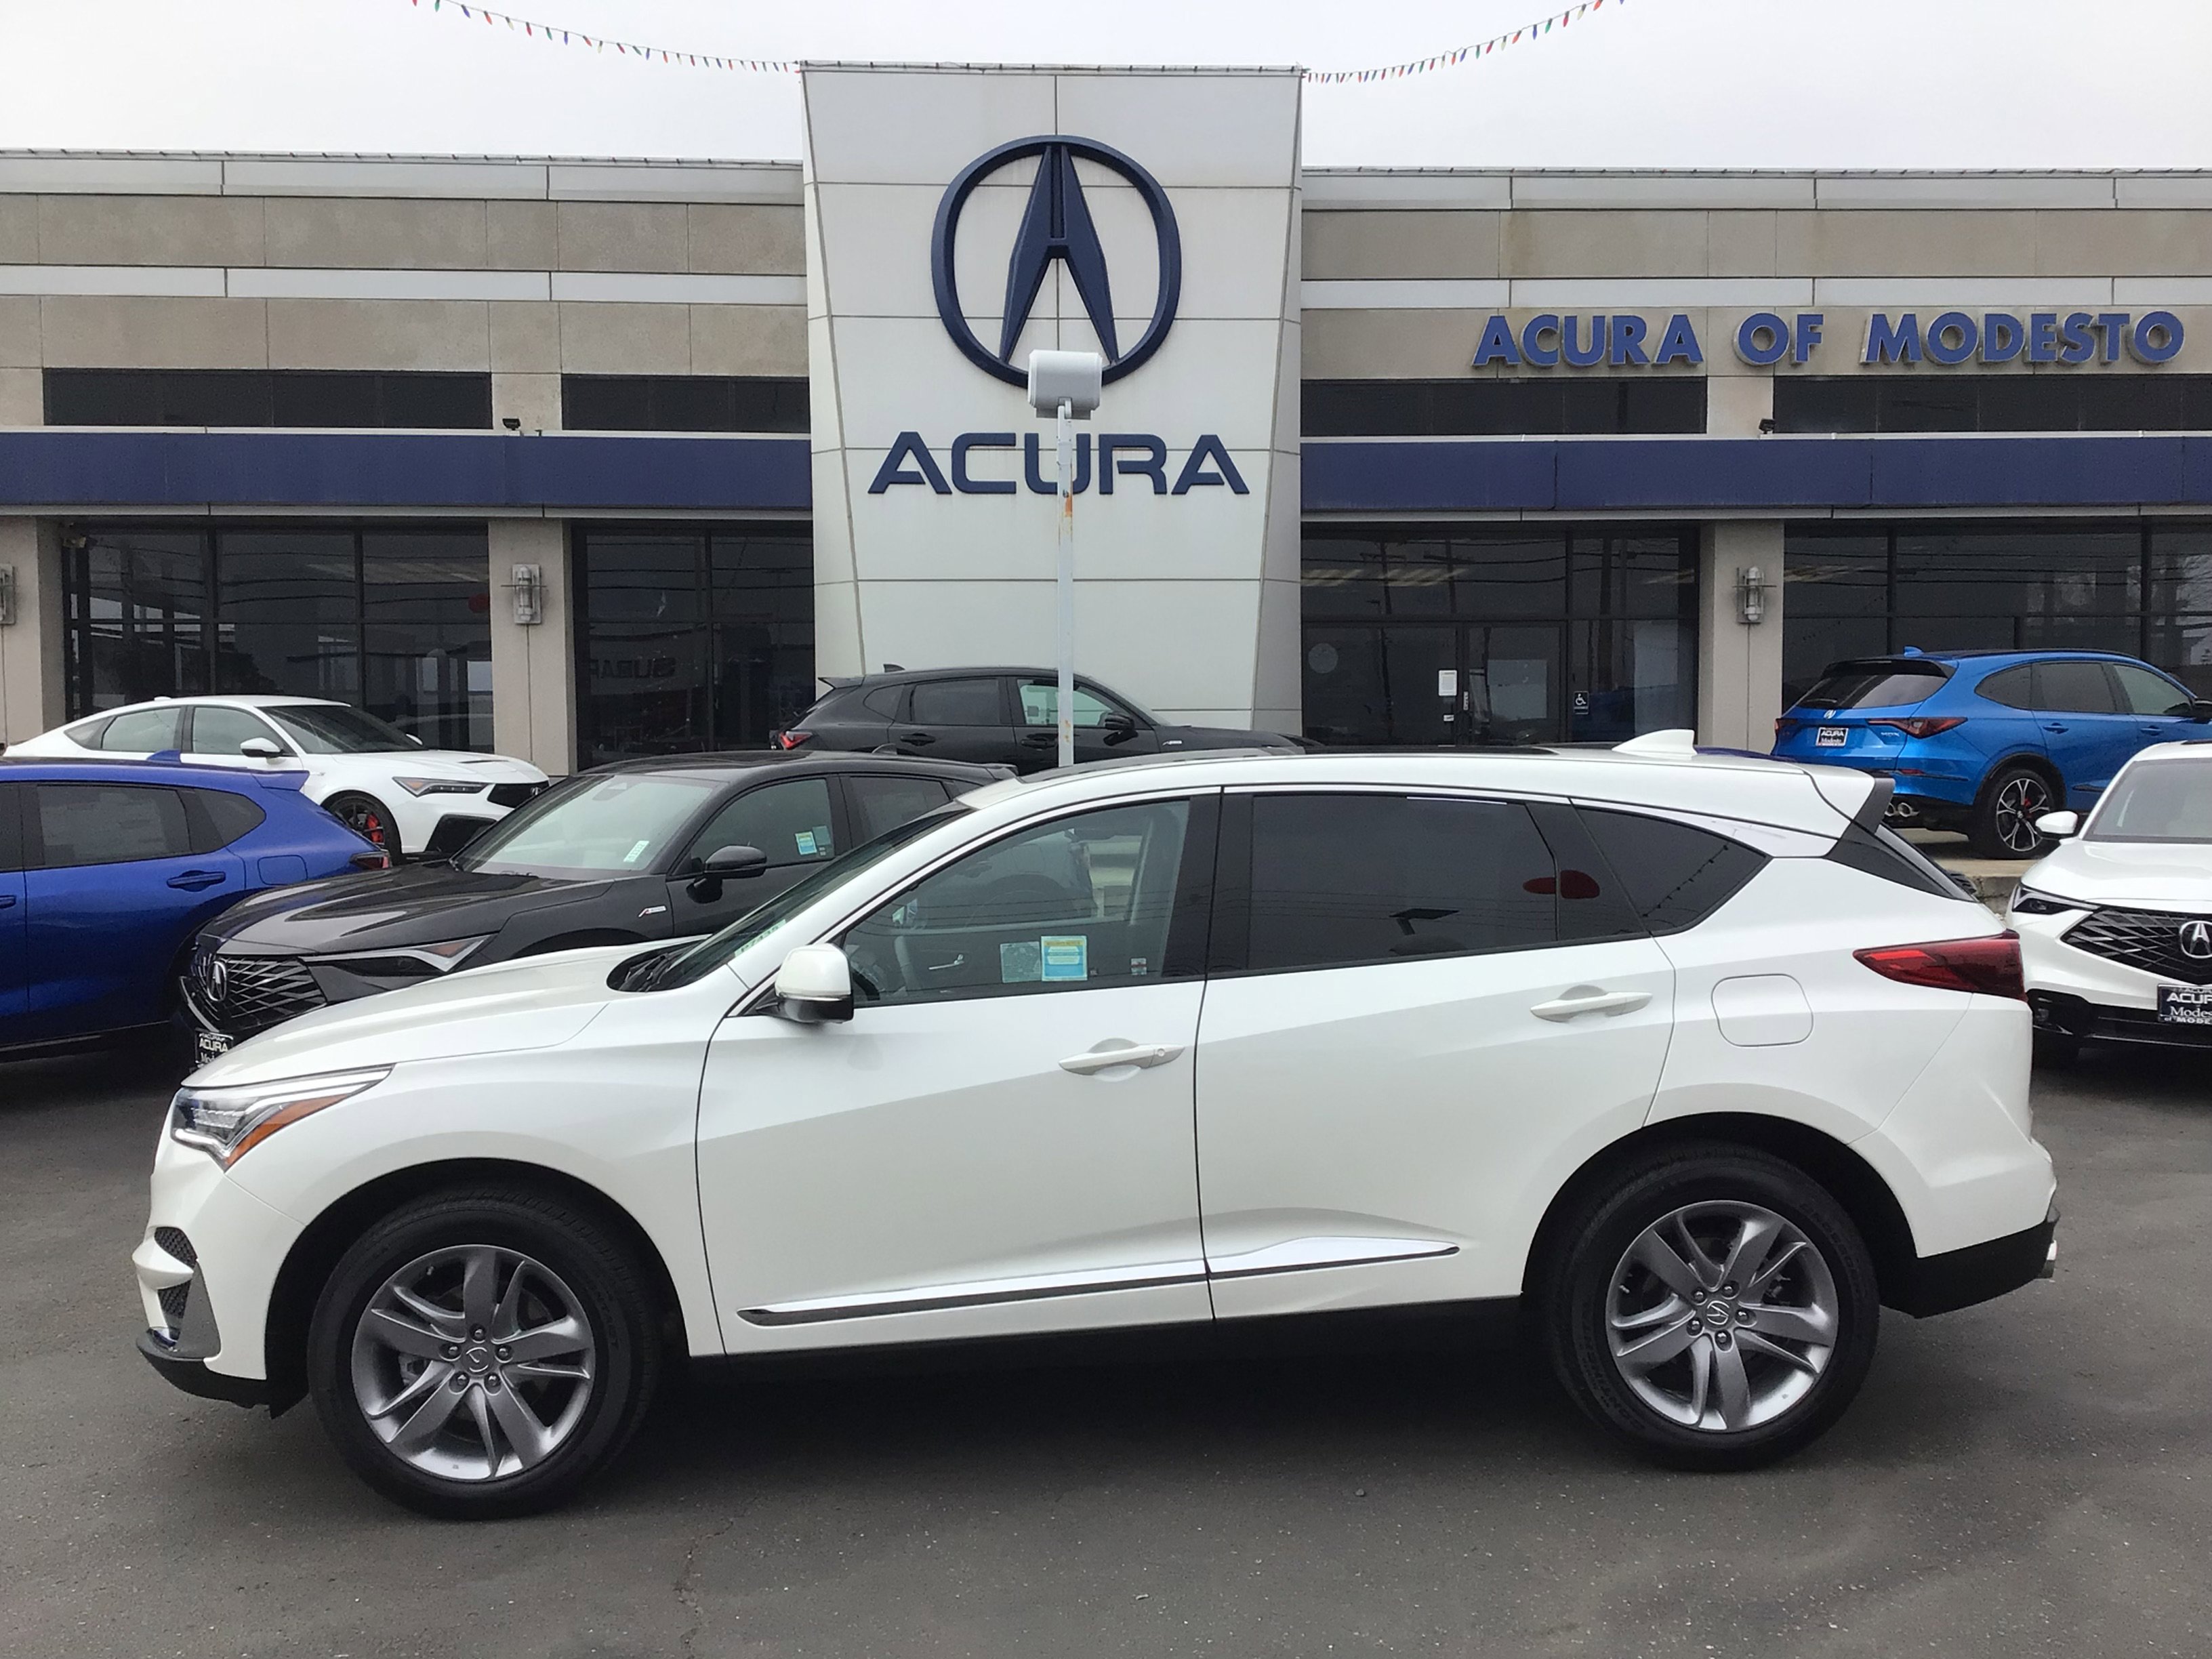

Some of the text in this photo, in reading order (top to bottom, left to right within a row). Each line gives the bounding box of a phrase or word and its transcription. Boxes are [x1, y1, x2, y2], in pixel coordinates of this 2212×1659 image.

[1471, 310, 2186, 367] ACURA OF MODESTO
[867, 431, 1250, 495] ACURA
[199, 1038, 228, 1052] ACURA
